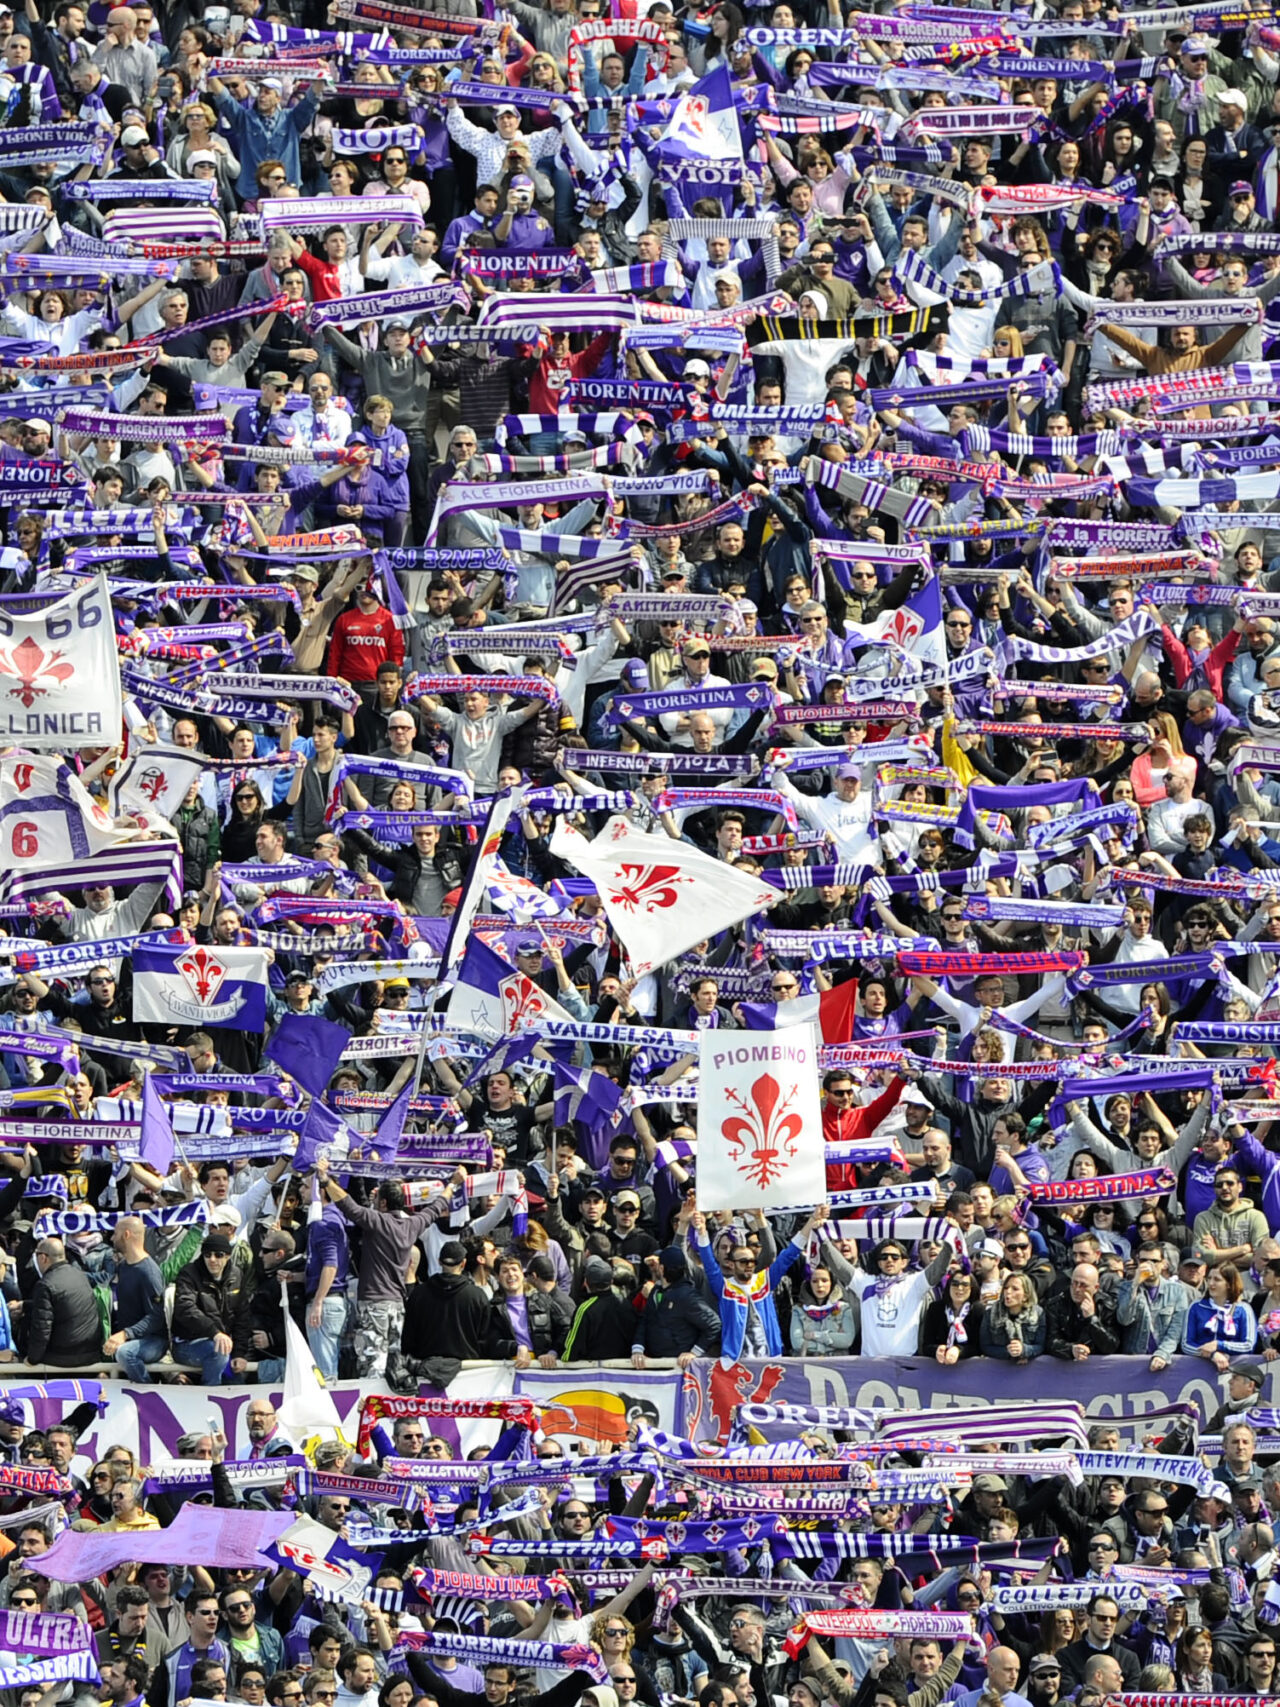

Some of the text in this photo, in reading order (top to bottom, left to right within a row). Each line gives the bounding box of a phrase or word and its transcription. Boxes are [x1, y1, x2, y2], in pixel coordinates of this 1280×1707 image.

[880, 24, 972, 39] la FIORENTINA
[388, 47, 463, 61] FIORENTINA
[1004, 59, 1091, 72] FIORENTINA
[662, 165, 758, 185] VIOLA
[39, 351, 136, 370] FIORENTINA
[571, 383, 687, 402] FIORENTINA
[100, 423, 187, 436] la FIORENTINA
[504, 477, 590, 497] FIORENTINA
[1075, 527, 1090, 540] la
[1081, 558, 1183, 576] FIORENTINA
[45, 588, 104, 641] 66
[347, 636, 386, 648] TOYOTA
[455, 636, 553, 650] FIORENTINA
[881, 660, 976, 696] COLLETTIVO
[644, 690, 735, 710] FIORENTINA
[784, 703, 910, 720] FIORENTINA
[585, 754, 731, 773] INFERNO VIOLA
[798, 754, 839, 766] Fiorentina
[11, 820, 39, 858] 6
[257, 931, 366, 953] FIORENZA
[811, 938, 913, 962] ULTRAS
[39, 931, 170, 972] FIORENZA
[547, 1021, 675, 1048] VALDELSA
[22, 1037, 59, 1055] Nostro
[713, 1041, 807, 1071] PIOMBINO
[832, 1048, 905, 1064] FIORENTINA
[933, 1060, 1059, 1076] FORZA FIORENTINA
[172, 1074, 259, 1088] FIORENTINA
[33, 1124, 135, 1141] FIORENTINA
[1029, 1173, 1155, 1200] FIORENTINA
[384, 1400, 486, 1417] LIVERPOOL
[412, 1463, 482, 1478] COLLETTIVO
[737, 1466, 770, 1480] CLUB
[774, 1466, 807, 1480] NEW
[809, 1466, 841, 1480] YORK
[492, 1539, 636, 1555] COLLETTIVO
[434, 1569, 539, 1593] FIORENTINA
[685, 1576, 831, 1597] FIORENTINA
[999, 1585, 1140, 1604] COLLETTIVO
[816, 1614, 964, 1631] LIVERPOOL FIORENTINA
[434, 1632, 554, 1661] FIORENTINA
